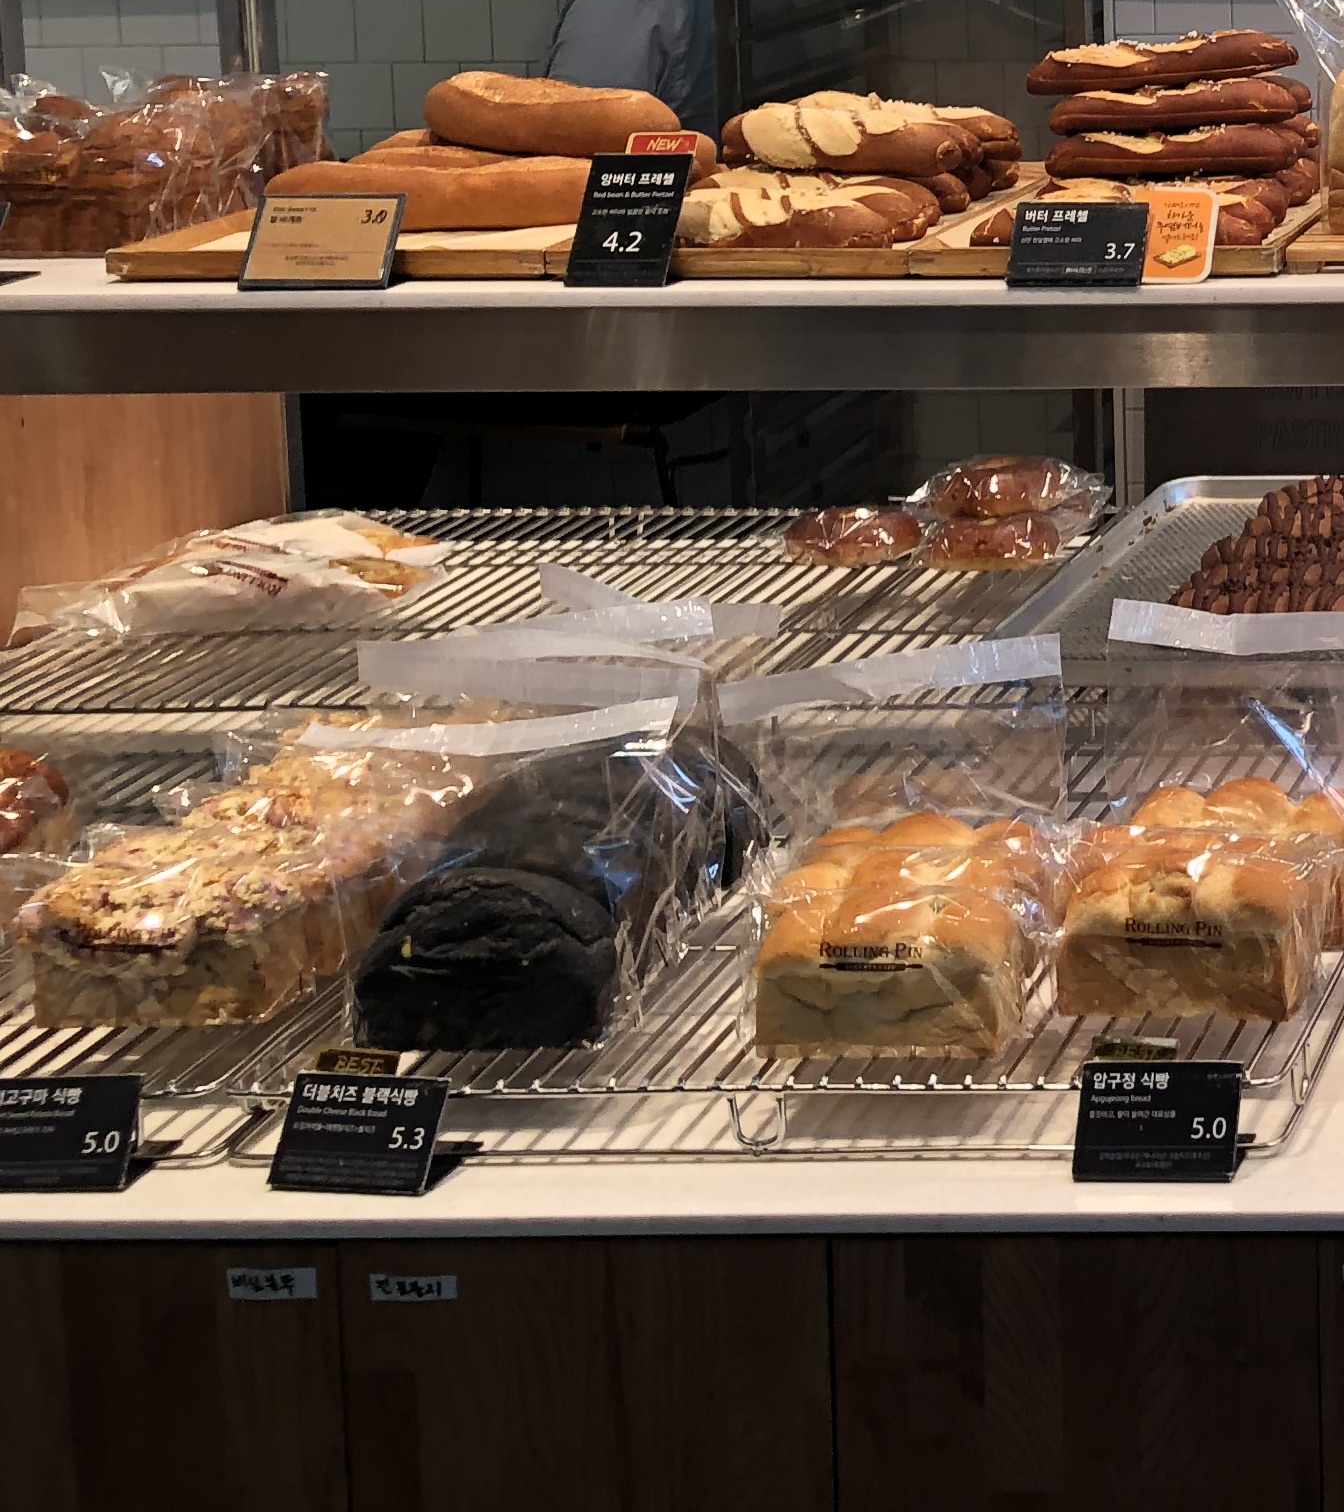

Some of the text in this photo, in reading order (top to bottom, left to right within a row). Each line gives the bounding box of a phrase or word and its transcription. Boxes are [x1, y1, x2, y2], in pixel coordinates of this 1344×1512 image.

[647, 137, 681, 151] NEW
[601, 172, 675, 186] 앙버터 프레첼
[1025, 210, 1089, 223] 버터 프레첼
[602, 231, 642, 253] 4.2
[1105, 243, 1135, 259] 3.7
[1125, 917, 1222, 937] ROLLING PIN
[820, 941, 923, 959] ROLLING PIN
[335, 1056, 386, 1075] BEST
[1093, 1072, 1170, 1090] 압구정 식빵
[0, 1088, 83, 1107] 고구마 식빵
[302, 1083, 419, 1107] 더블치즈 블랙식빵
[388, 1126, 425, 1150] 5.3
[1190, 1117, 1227, 1140] 5.0
[81, 1130, 120, 1154] 5.0
